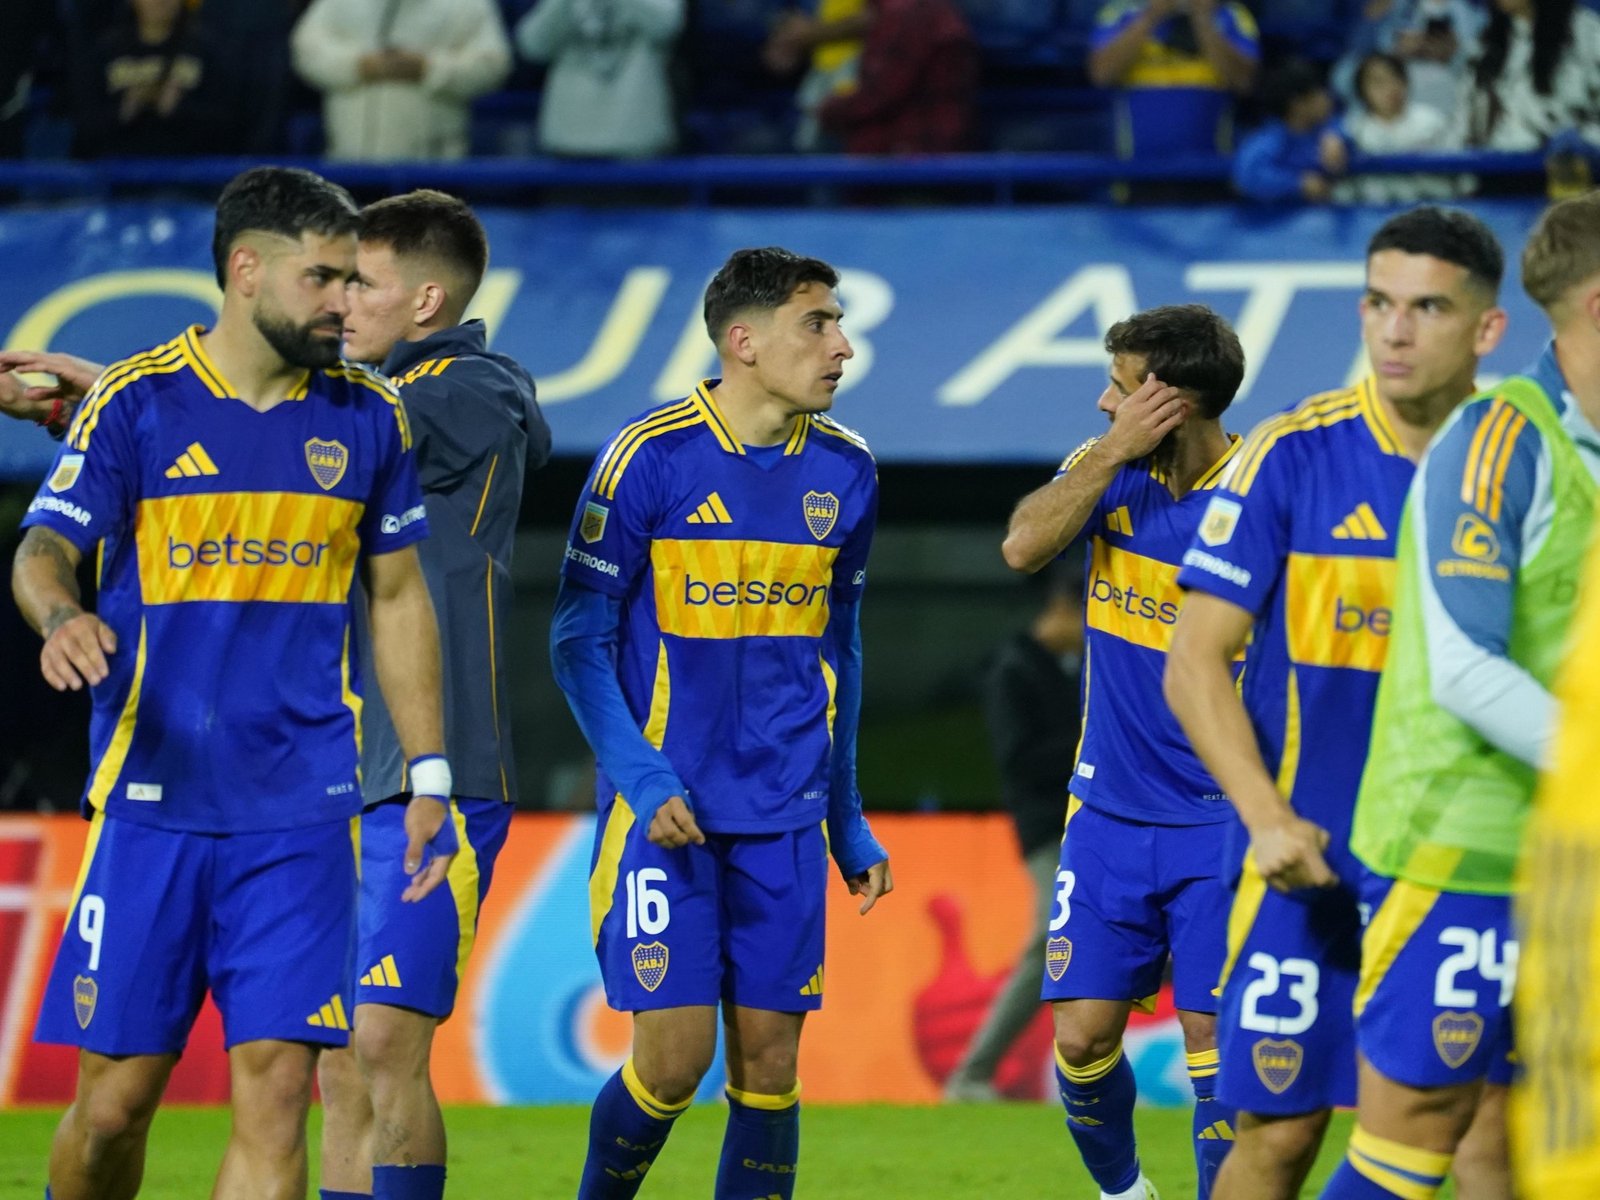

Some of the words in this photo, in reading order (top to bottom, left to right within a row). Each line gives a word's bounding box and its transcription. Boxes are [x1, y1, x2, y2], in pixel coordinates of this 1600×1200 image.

[3, 266, 894, 408] CUB
[807, 507, 834, 519] CABJ
[684, 574, 828, 607] betsson
[79, 894, 105, 971] 9
[626, 867, 670, 938] 16
[1049, 870, 1076, 931] 3
[636, 957, 664, 970] CABJ
[1240, 951, 1320, 1035] 23
[1433, 926, 1520, 1008] 24
